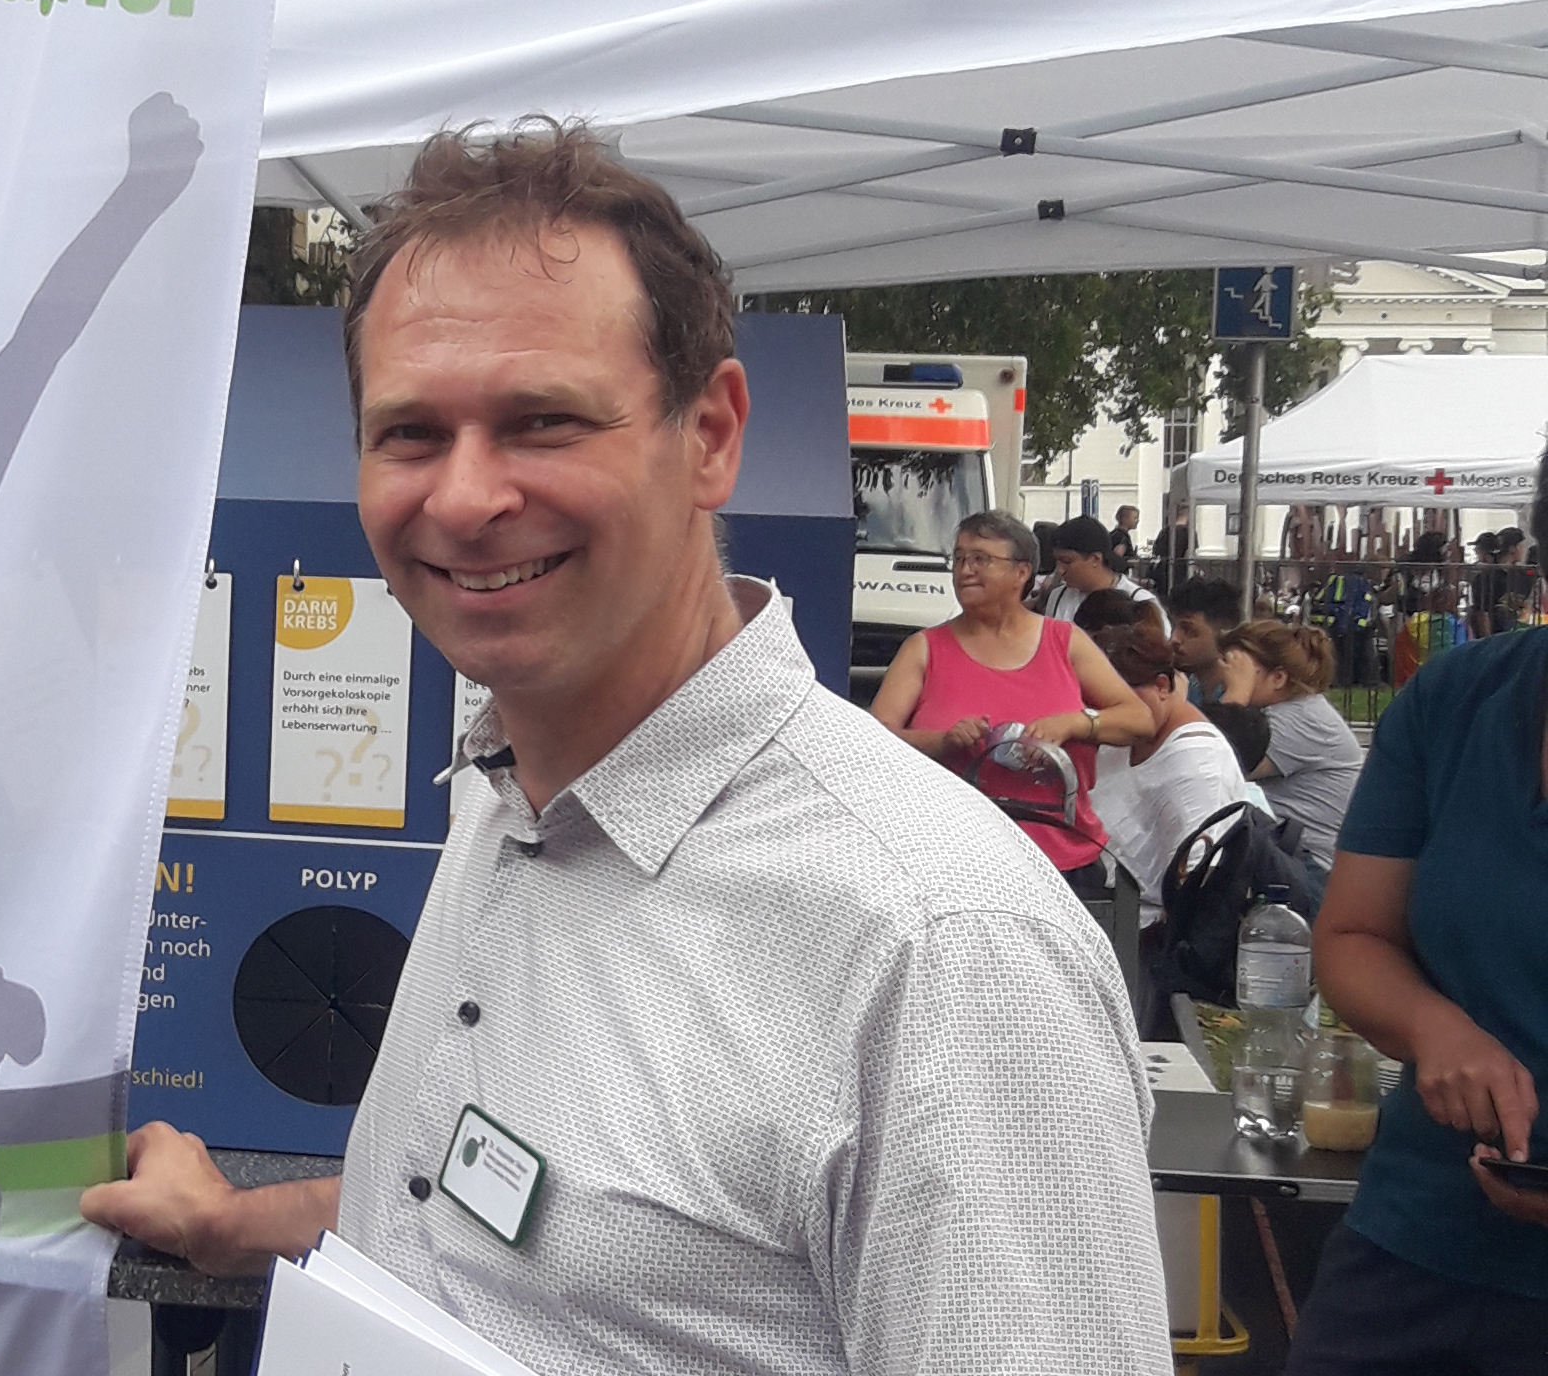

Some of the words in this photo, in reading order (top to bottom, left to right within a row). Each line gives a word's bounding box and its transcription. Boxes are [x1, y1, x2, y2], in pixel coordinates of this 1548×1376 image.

[878, 398, 922, 409] Kreuz
[1214, 469, 1306, 484] Desches
[1310, 471, 1361, 485] Rotes
[1367, 472, 1418, 487] Kreuz
[1460, 473, 1511, 487] Moers
[852, 580, 946, 595] WAGEN
[283, 599, 338, 615] DARM
[283, 615, 338, 631] KREBS
[283, 670, 316, 682] Durch
[318, 672, 343, 683] eine
[345, 673, 401, 687] einmalige
[282, 687, 391, 701] Vorsorgekoloskopie
[282, 703, 319, 715] erhöht
[322, 705, 343, 715] sich
[345, 706, 368, 717] Ihre
[281, 719, 378, 735] Lebenserwartung
[300, 868, 378, 891] POLYP
[161, 938, 211, 958] noch
[132, 1067, 204, 1090] schied!
